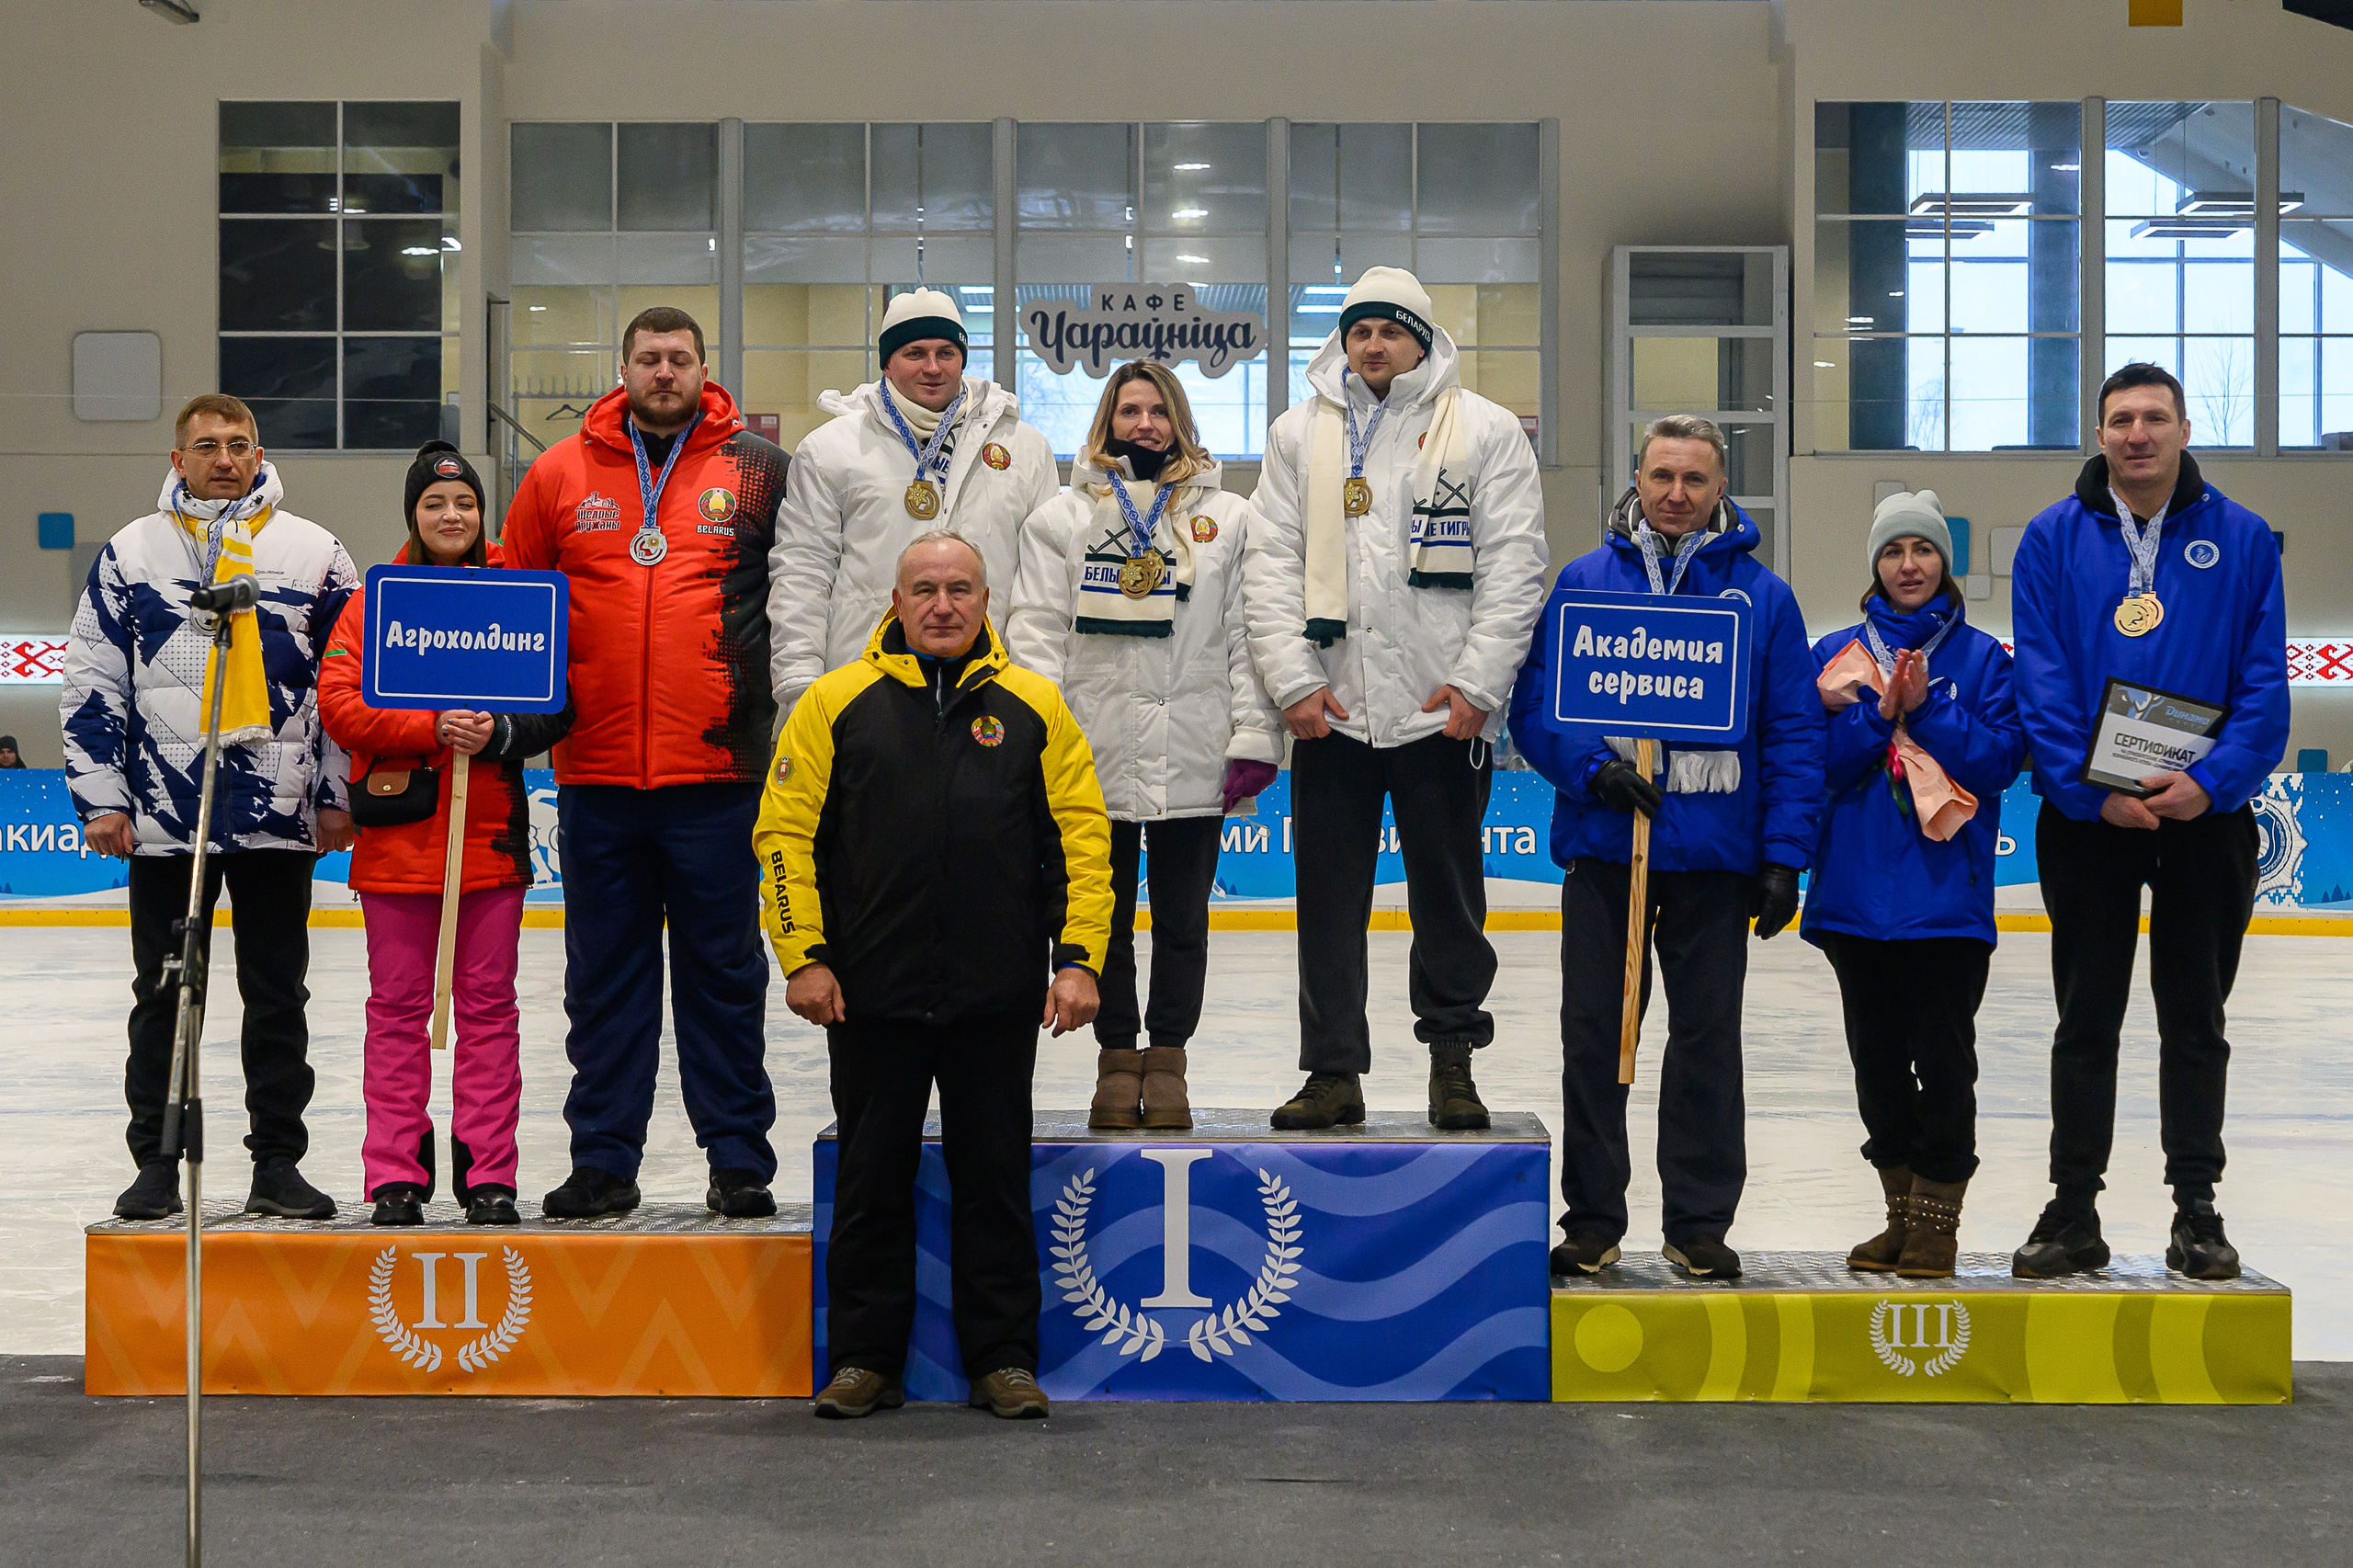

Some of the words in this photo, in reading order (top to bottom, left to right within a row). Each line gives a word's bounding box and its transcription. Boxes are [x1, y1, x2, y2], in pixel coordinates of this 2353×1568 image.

[1101, 293, 1186, 312] КАФЕ
[577, 509, 620, 521] Щедрые
[1084, 566, 1120, 584] БЕЛЫ
[385, 620, 546, 656] Агрохолдинг
[1573, 624, 1724, 665] Академия
[1587, 670, 1705, 705] сервиса
[2114, 733, 2197, 764] СЕРТИФИКАТ
[770, 849, 797, 935] BELARUS
[1140, 1149, 1213, 1308] I
[411, 1252, 489, 1329] II
[1886, 1303, 1954, 1348] III
